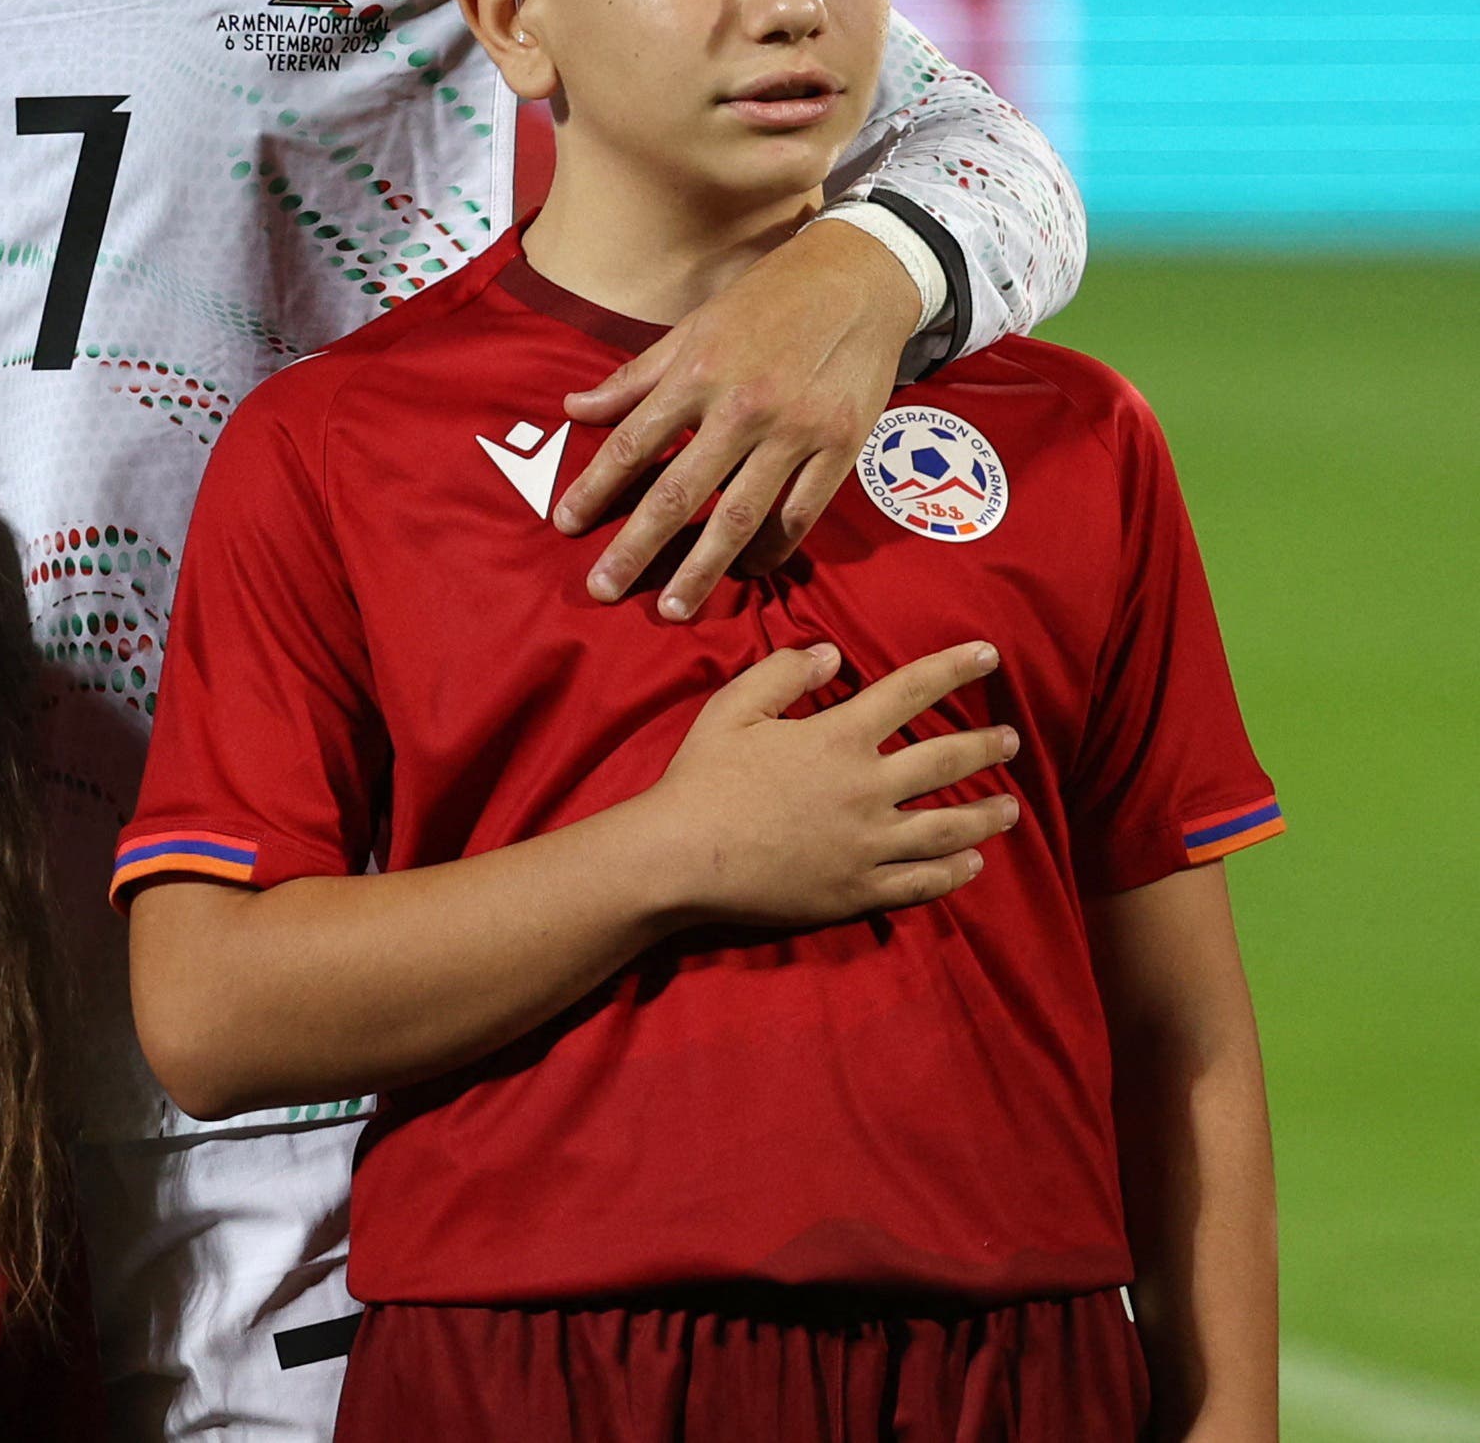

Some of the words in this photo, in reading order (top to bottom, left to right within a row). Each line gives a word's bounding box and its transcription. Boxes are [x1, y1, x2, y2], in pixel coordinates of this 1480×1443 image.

[225, 35, 235, 50] 6
[243, 34, 333, 53] SETEMBRO
[340, 36, 380, 54] 2025
[266, 53, 341, 71] YEREVAN
[15, 95, 132, 371] 7
[872, 411, 970, 441] FEDERATION
[971, 438, 991, 459] OF
[862, 441, 903, 517] FOOTBALL
[975, 462, 1002, 527] ARMENIA
